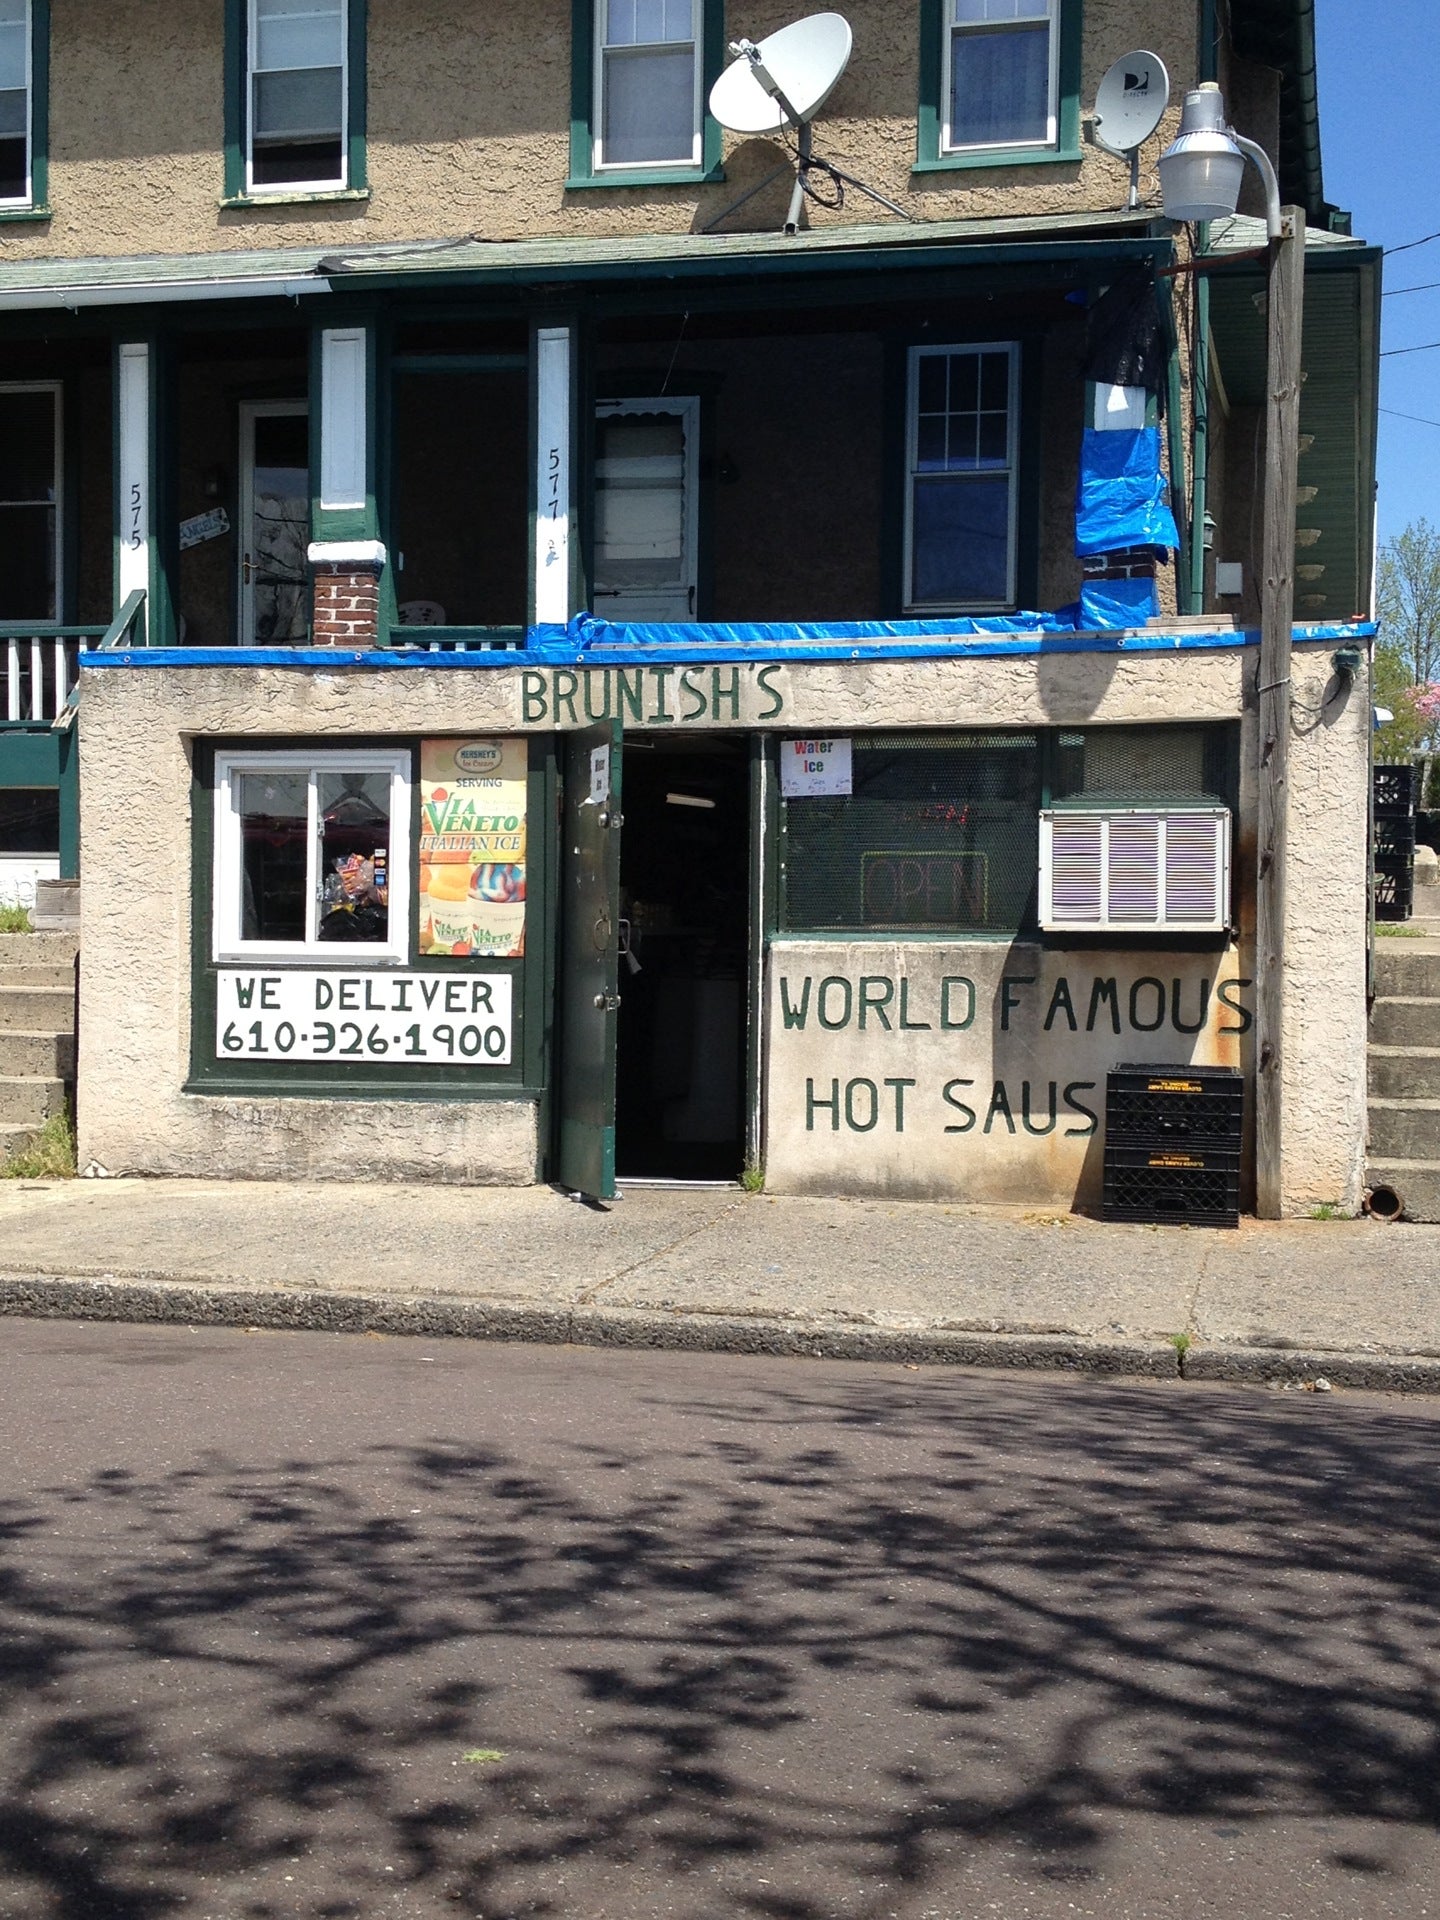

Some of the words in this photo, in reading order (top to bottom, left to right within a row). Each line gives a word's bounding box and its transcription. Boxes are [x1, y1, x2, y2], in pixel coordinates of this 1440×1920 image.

[548, 448, 560, 522] 577
[131, 483, 142, 551] 575
[522, 664, 784, 724] BRUNISH'S
[461, 750, 497, 759] HERSHEY'S
[794, 741, 834, 755] Water
[456, 777, 503, 788] SERVING
[424, 792, 477, 830] VIA
[420, 836, 491, 850] ITALIAN
[494, 836, 521, 850] ICE
[235, 977, 282, 1010] WE
[315, 978, 494, 1013] DELIVER
[778, 975, 977, 1032] WORLD
[1000, 976, 1254, 1035] FAMOUS
[805, 1077, 916, 1133] HOT
